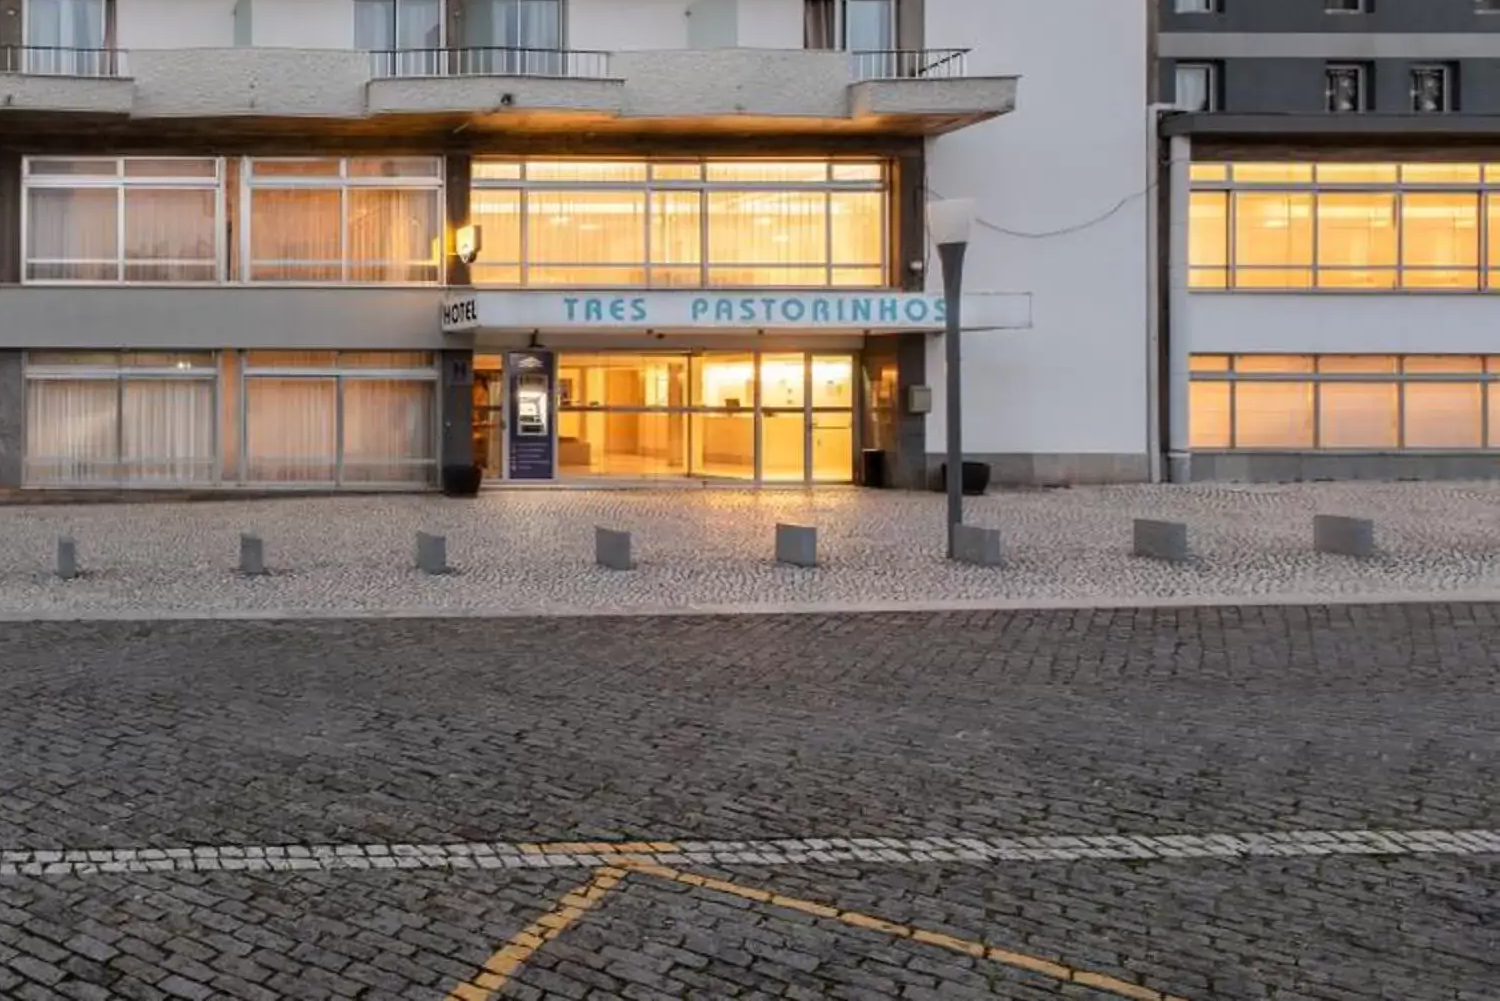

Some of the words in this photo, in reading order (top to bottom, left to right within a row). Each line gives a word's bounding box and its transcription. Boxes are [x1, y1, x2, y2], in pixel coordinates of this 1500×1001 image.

[443, 299, 477, 324] HOTEL
[564, 298, 647, 321] TRES
[691, 298, 947, 322] PASTORINHOS
